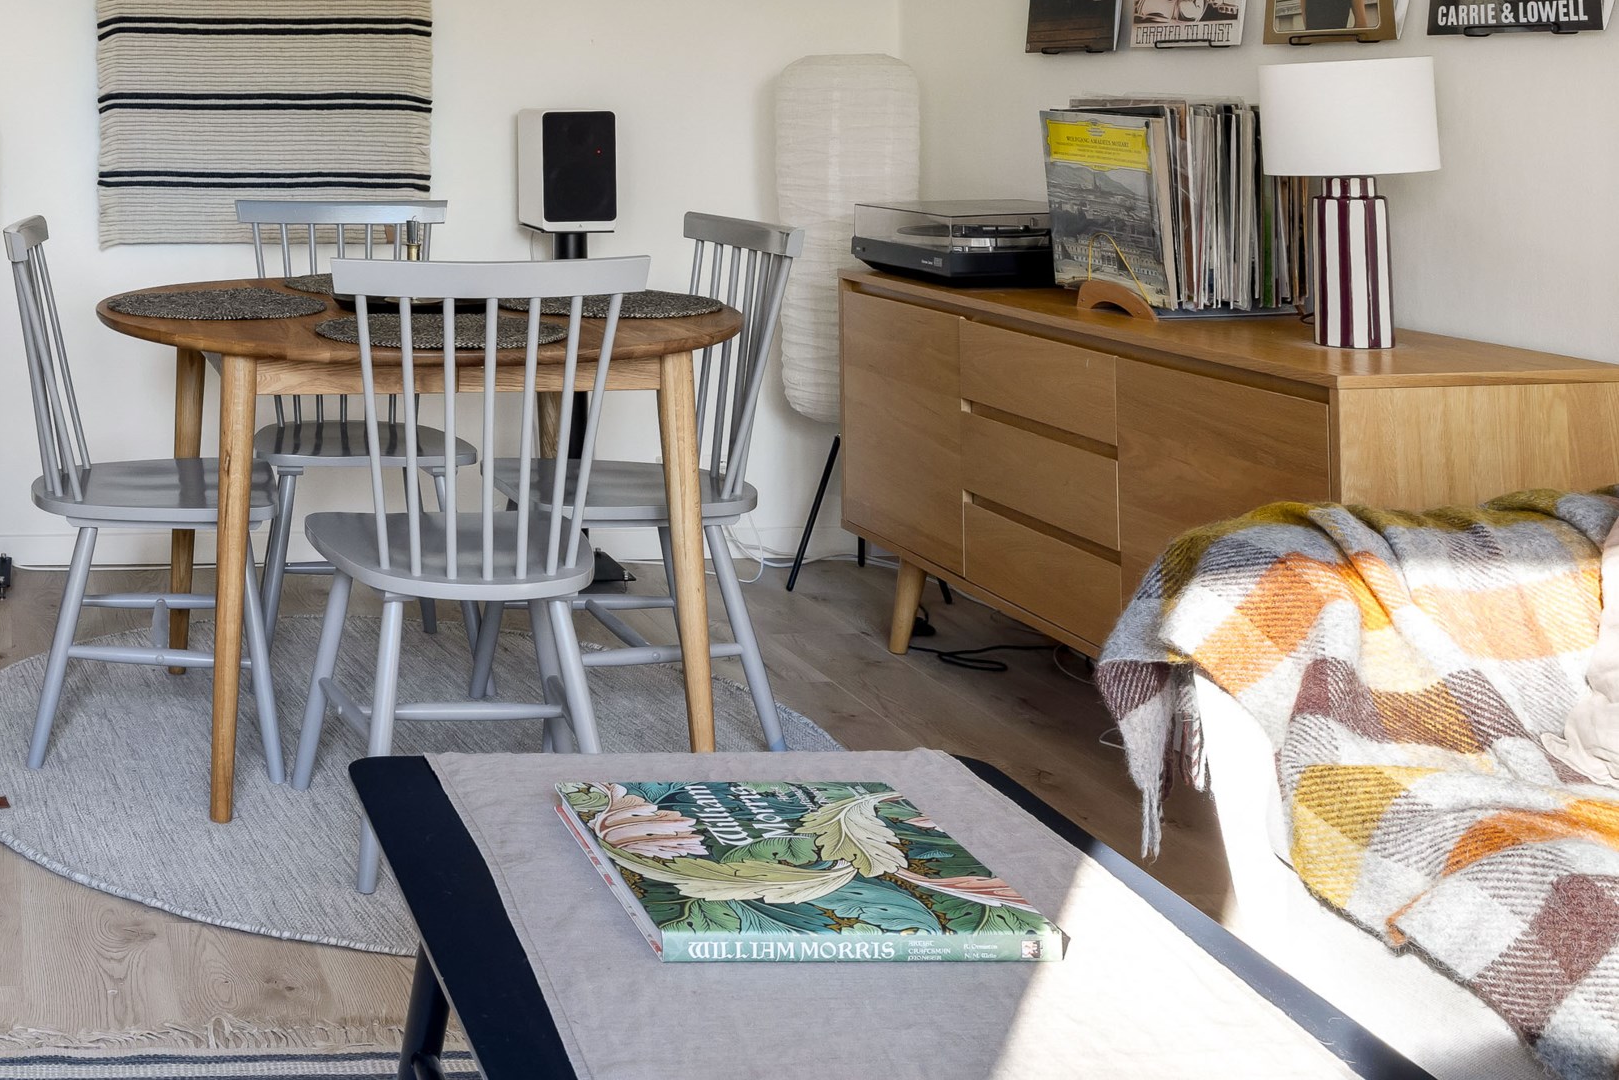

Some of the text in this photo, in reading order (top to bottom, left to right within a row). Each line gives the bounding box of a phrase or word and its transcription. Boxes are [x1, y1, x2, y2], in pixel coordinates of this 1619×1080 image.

[1437, 0, 1589, 26] CARRIE & LOWELL
[1135, 22, 1233, 44] CARRIED TO DUST
[685, 785, 754, 846] William
[729, 786, 810, 839] Morris
[687, 940, 896, 961] WILLIAM MORRIS
